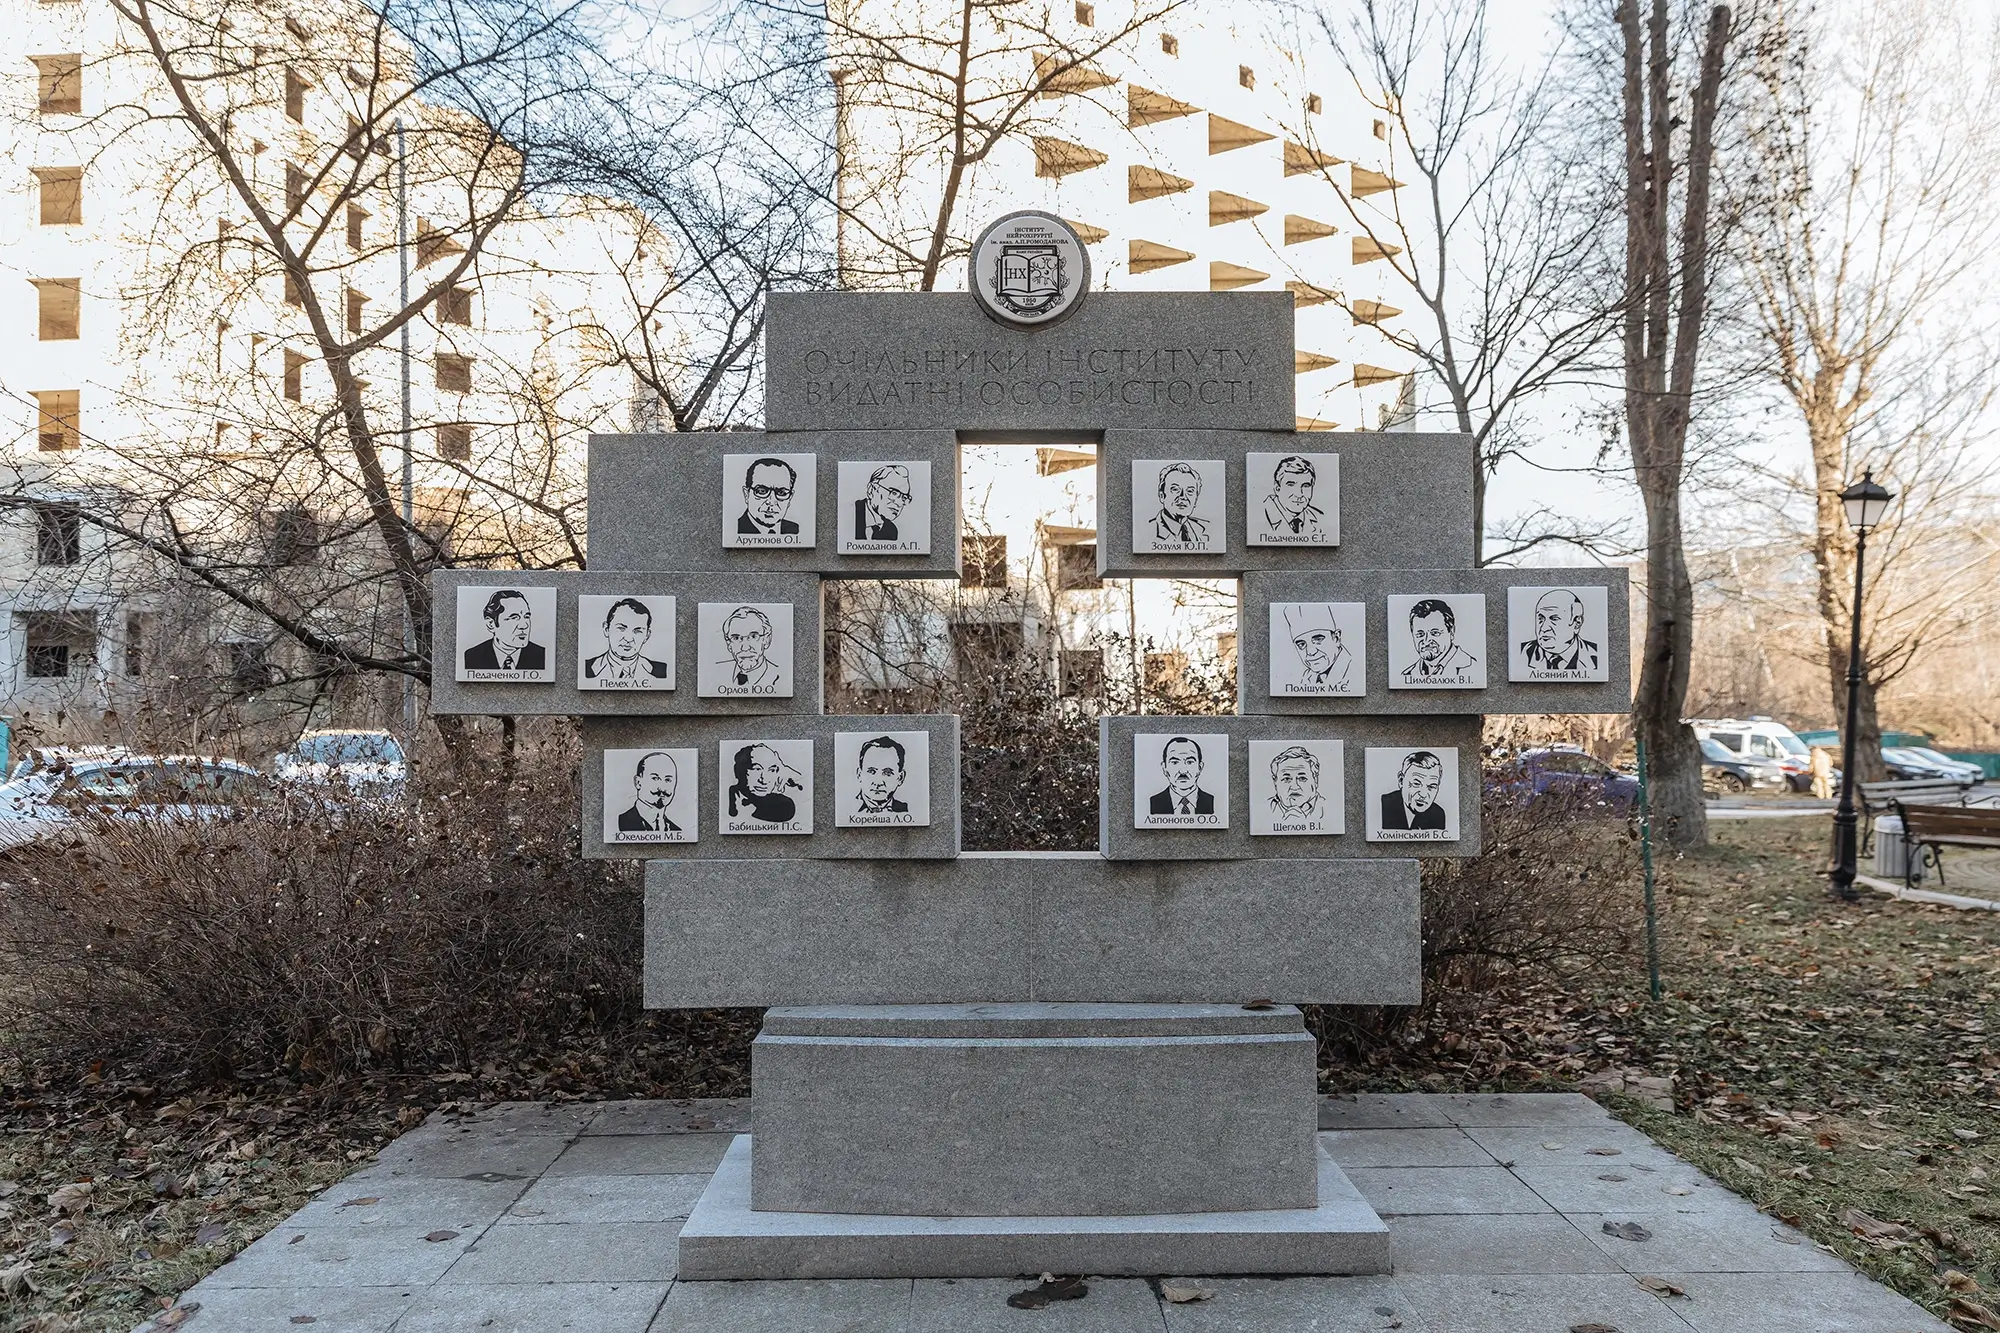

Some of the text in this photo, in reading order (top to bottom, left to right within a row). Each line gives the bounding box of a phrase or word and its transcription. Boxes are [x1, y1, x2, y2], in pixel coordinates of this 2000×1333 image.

[805, 348, 1257, 375] ОЧІЛЬНИКИ ІНСТИТУТУ
[806, 380, 1253, 407] ВИДАТНІ ОСОБИСТОСТІ
[735, 535, 802, 546] Арутюнов О.І.
[1259, 534, 1329, 544] Педаченко Є.Г.
[846, 541, 921, 551] Ромоданов А.П.
[1151, 541, 1209, 552] Зозуля Ю.П.
[467, 670, 542, 680] Педаченко Г.О.
[1404, 675, 1474, 685] Цимбалюк В.І.
[1528, 669, 1591, 680] Лісяний М.І.
[600, 679, 652, 689] Пелех Л.Є.
[717, 684, 777, 695] Орлов Ю.О.
[1285, 683, 1351, 693] Поліщук М.Є.
[849, 814, 915, 825] Корейша Л.О.
[1143, 814, 1221, 824] Лапоногов О.О.
[728, 821, 803, 832] Бабицький П.С.
[1272, 821, 1324, 832] Щеглов В.І.
[615, 832, 686, 841] Юкельсон М.Б.
[1376, 829, 1452, 840] Хомінський Б.С.
